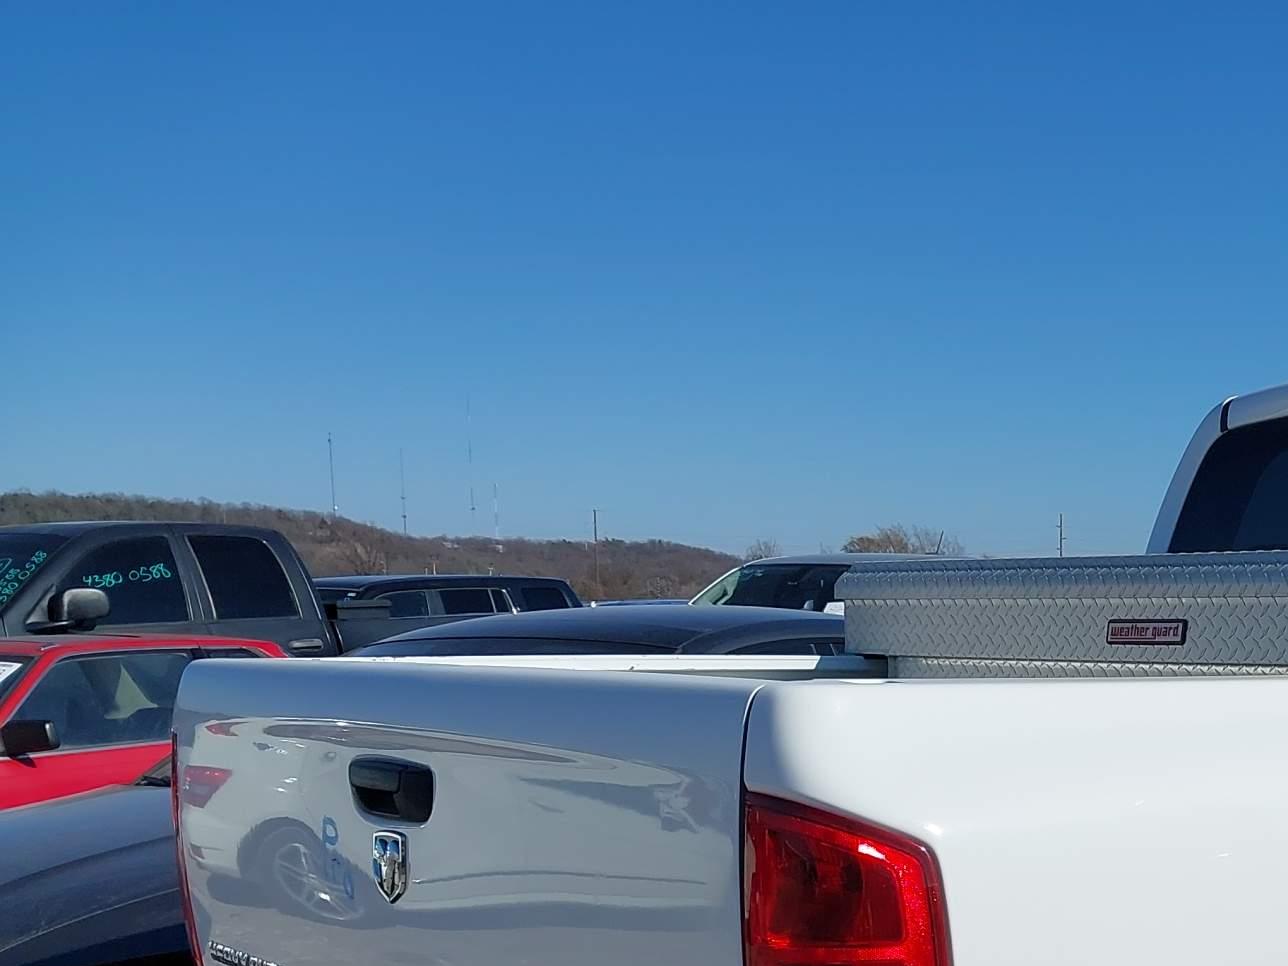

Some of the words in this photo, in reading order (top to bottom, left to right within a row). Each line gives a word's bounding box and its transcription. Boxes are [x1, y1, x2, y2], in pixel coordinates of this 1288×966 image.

[82, 571, 123, 588] 4380
[128, 562, 171, 582] 0588
[1110, 624, 1150, 637] weather
[1151, 624, 1180, 640] guard
